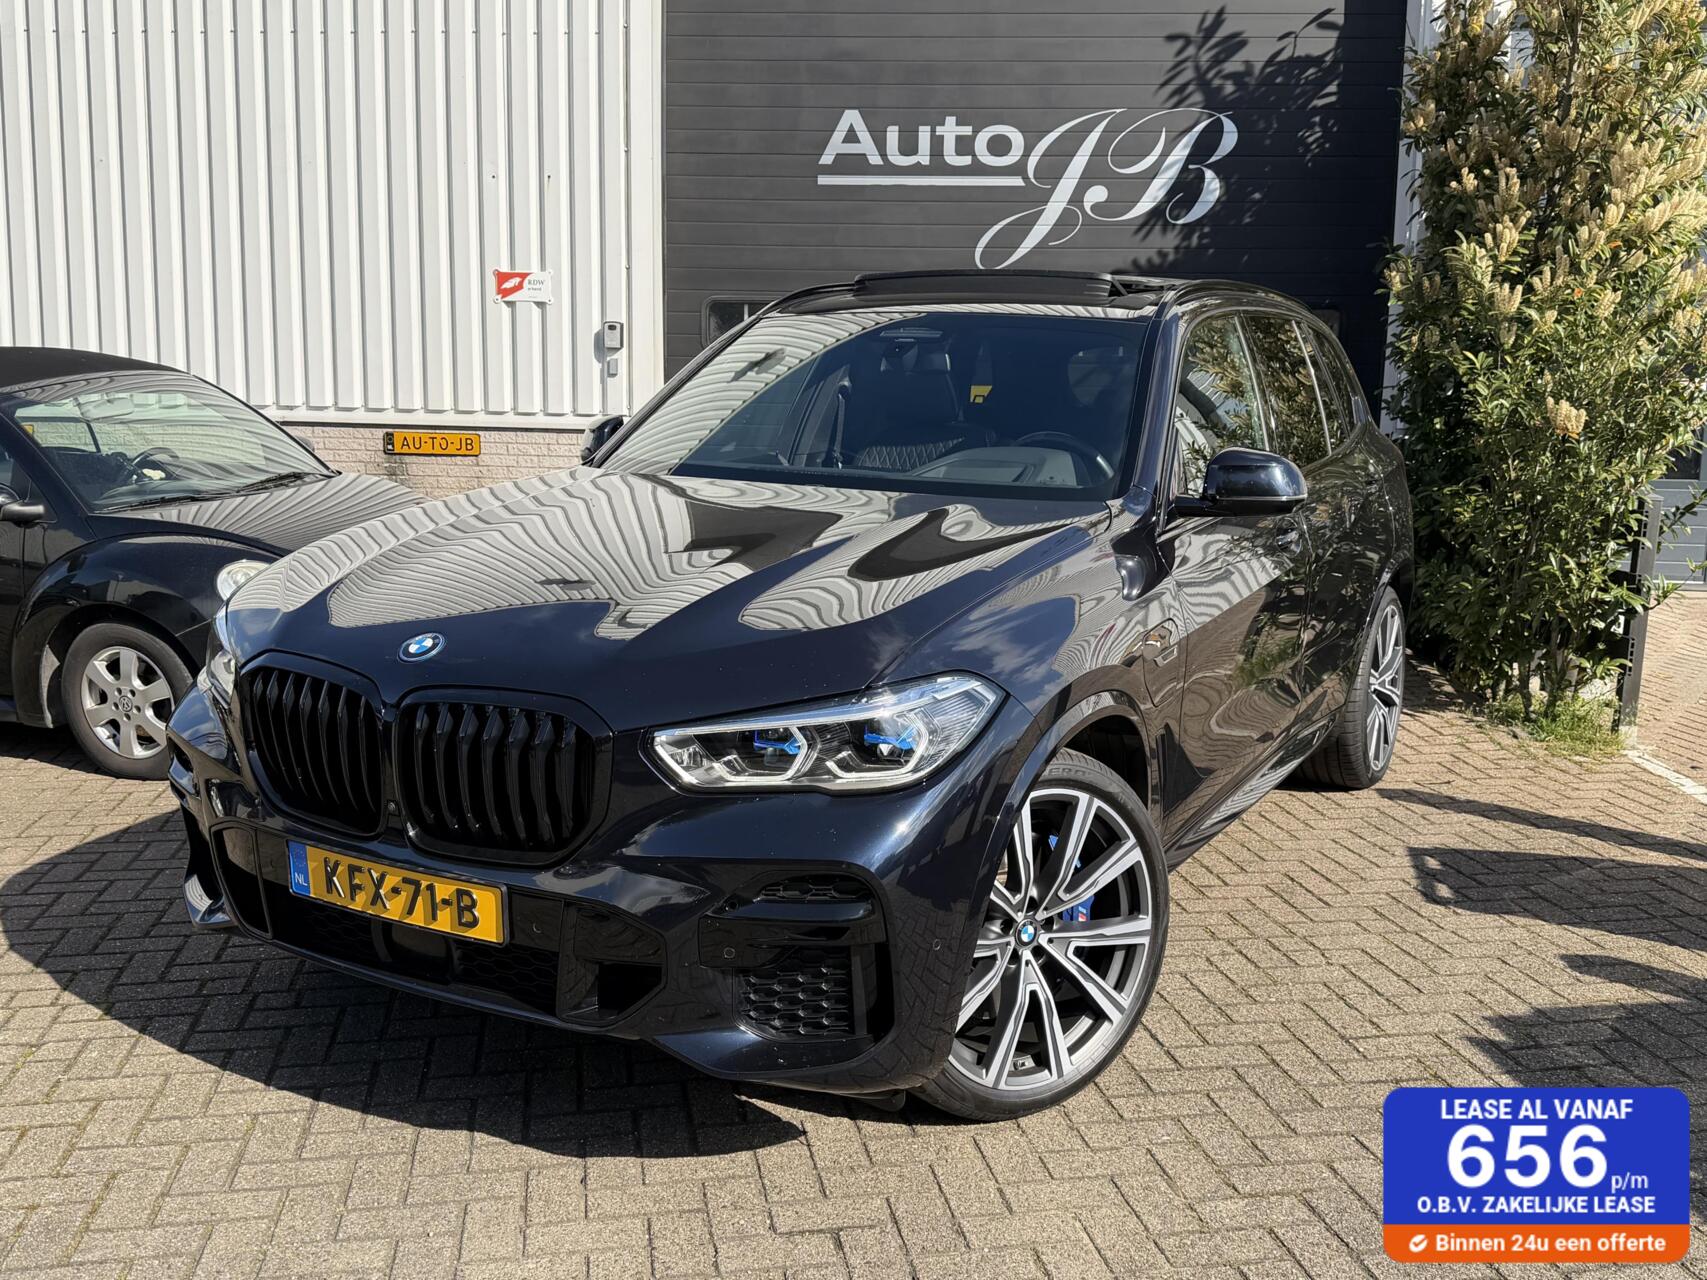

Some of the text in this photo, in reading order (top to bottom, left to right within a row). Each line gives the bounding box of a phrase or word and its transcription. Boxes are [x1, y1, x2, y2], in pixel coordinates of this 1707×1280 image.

[818, 108, 1239, 270] Auto JB
[400, 436, 475, 452] AU-TO-JB
[294, 872, 308, 887] NL
[323, 856, 480, 929] KFX-71-B
